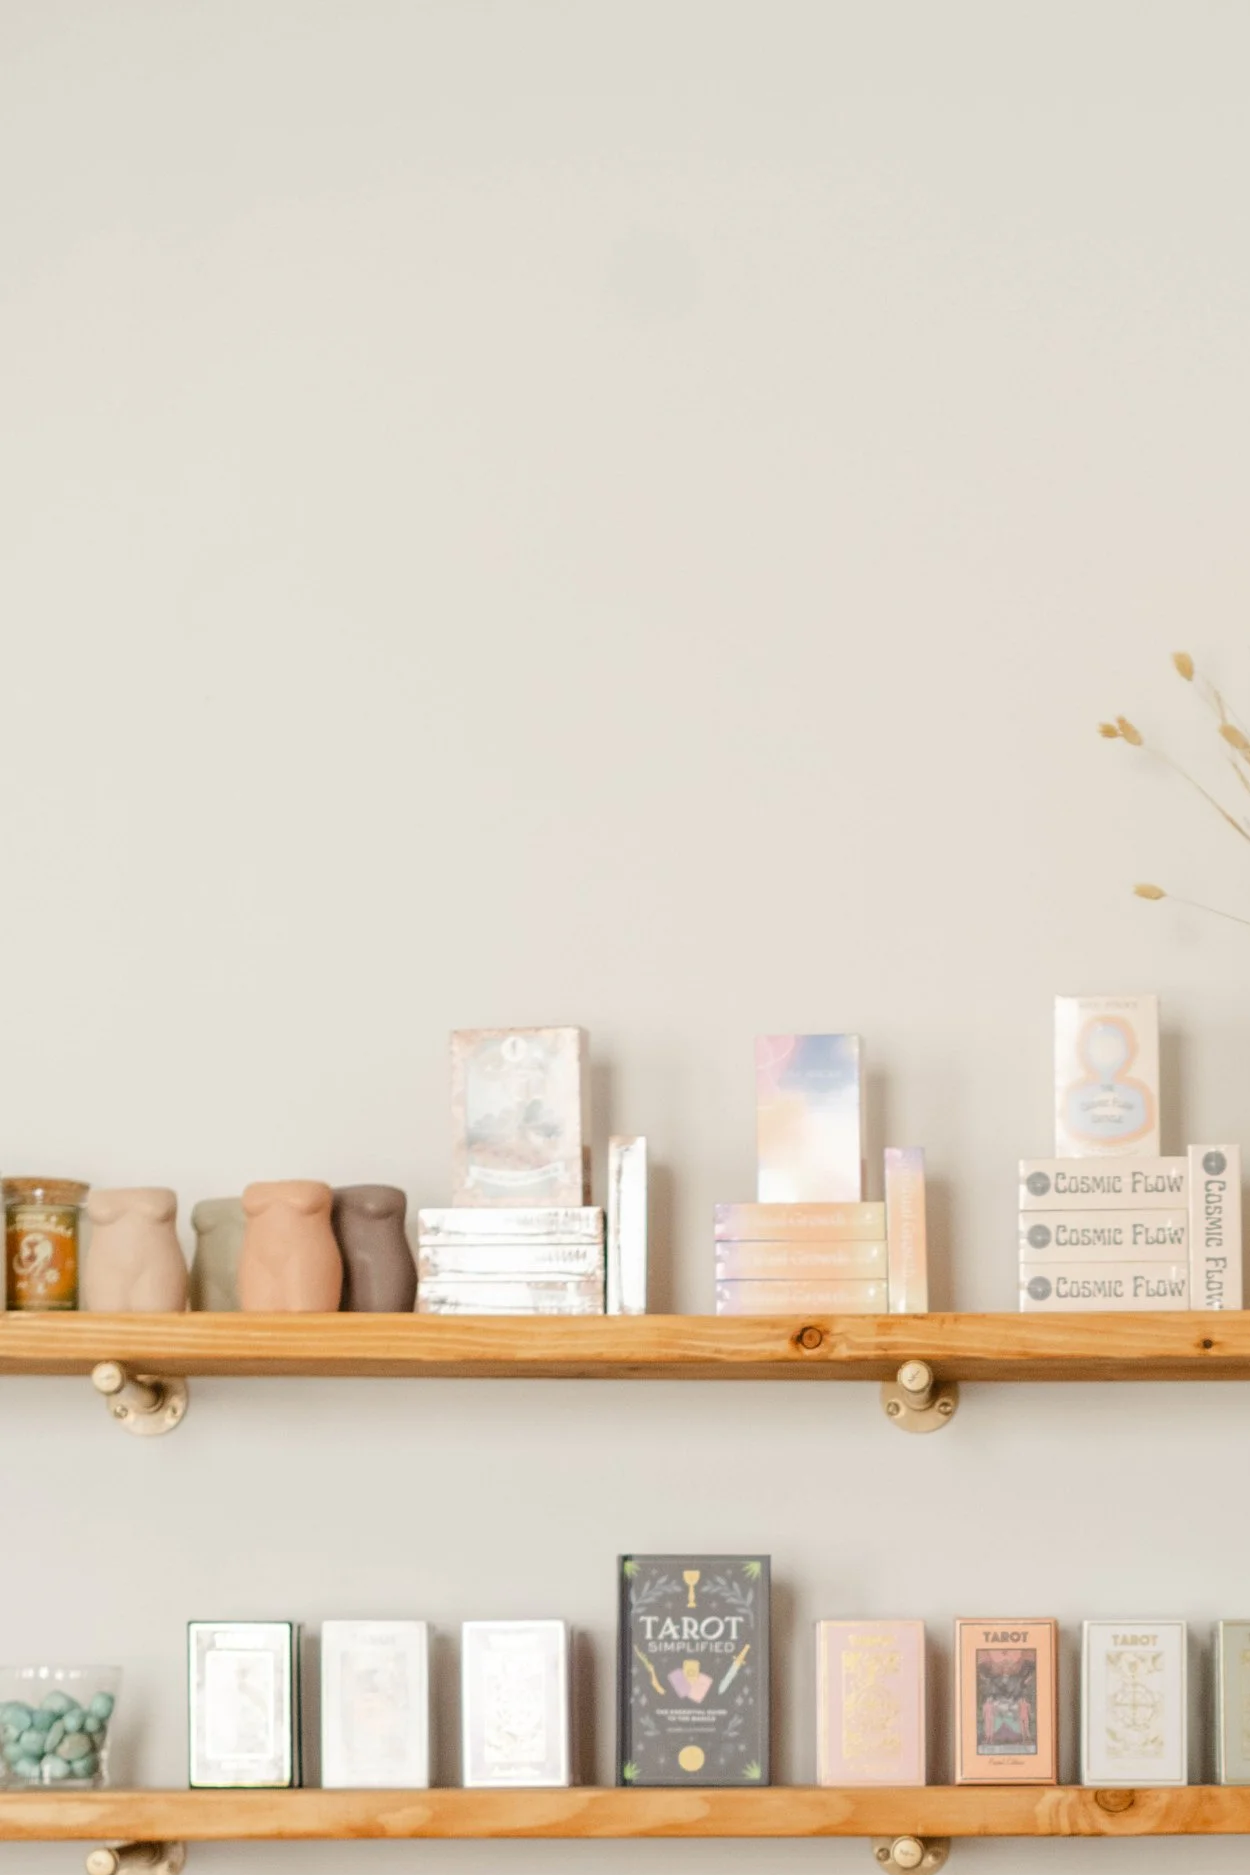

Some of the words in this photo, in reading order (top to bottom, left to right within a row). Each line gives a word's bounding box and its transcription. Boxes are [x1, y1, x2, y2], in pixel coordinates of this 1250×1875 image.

[1054, 1172, 1122, 1193] COSMIC
[1131, 1171, 1184, 1193] FLOW
[1205, 1179, 1226, 1248] COSMIC
[1055, 1225, 1123, 1246] COSMIC
[1132, 1224, 1184, 1245] FLOW
[1056, 1277, 1124, 1298] COSMIC
[1133, 1276, 1185, 1297] FLOW
[639, 1616, 744, 1640] TAROT
[983, 1631, 1029, 1643] TAROT
[648, 1641, 735, 1653] SIMPLIFIED
[1111, 1634, 1158, 1646] TAROT
